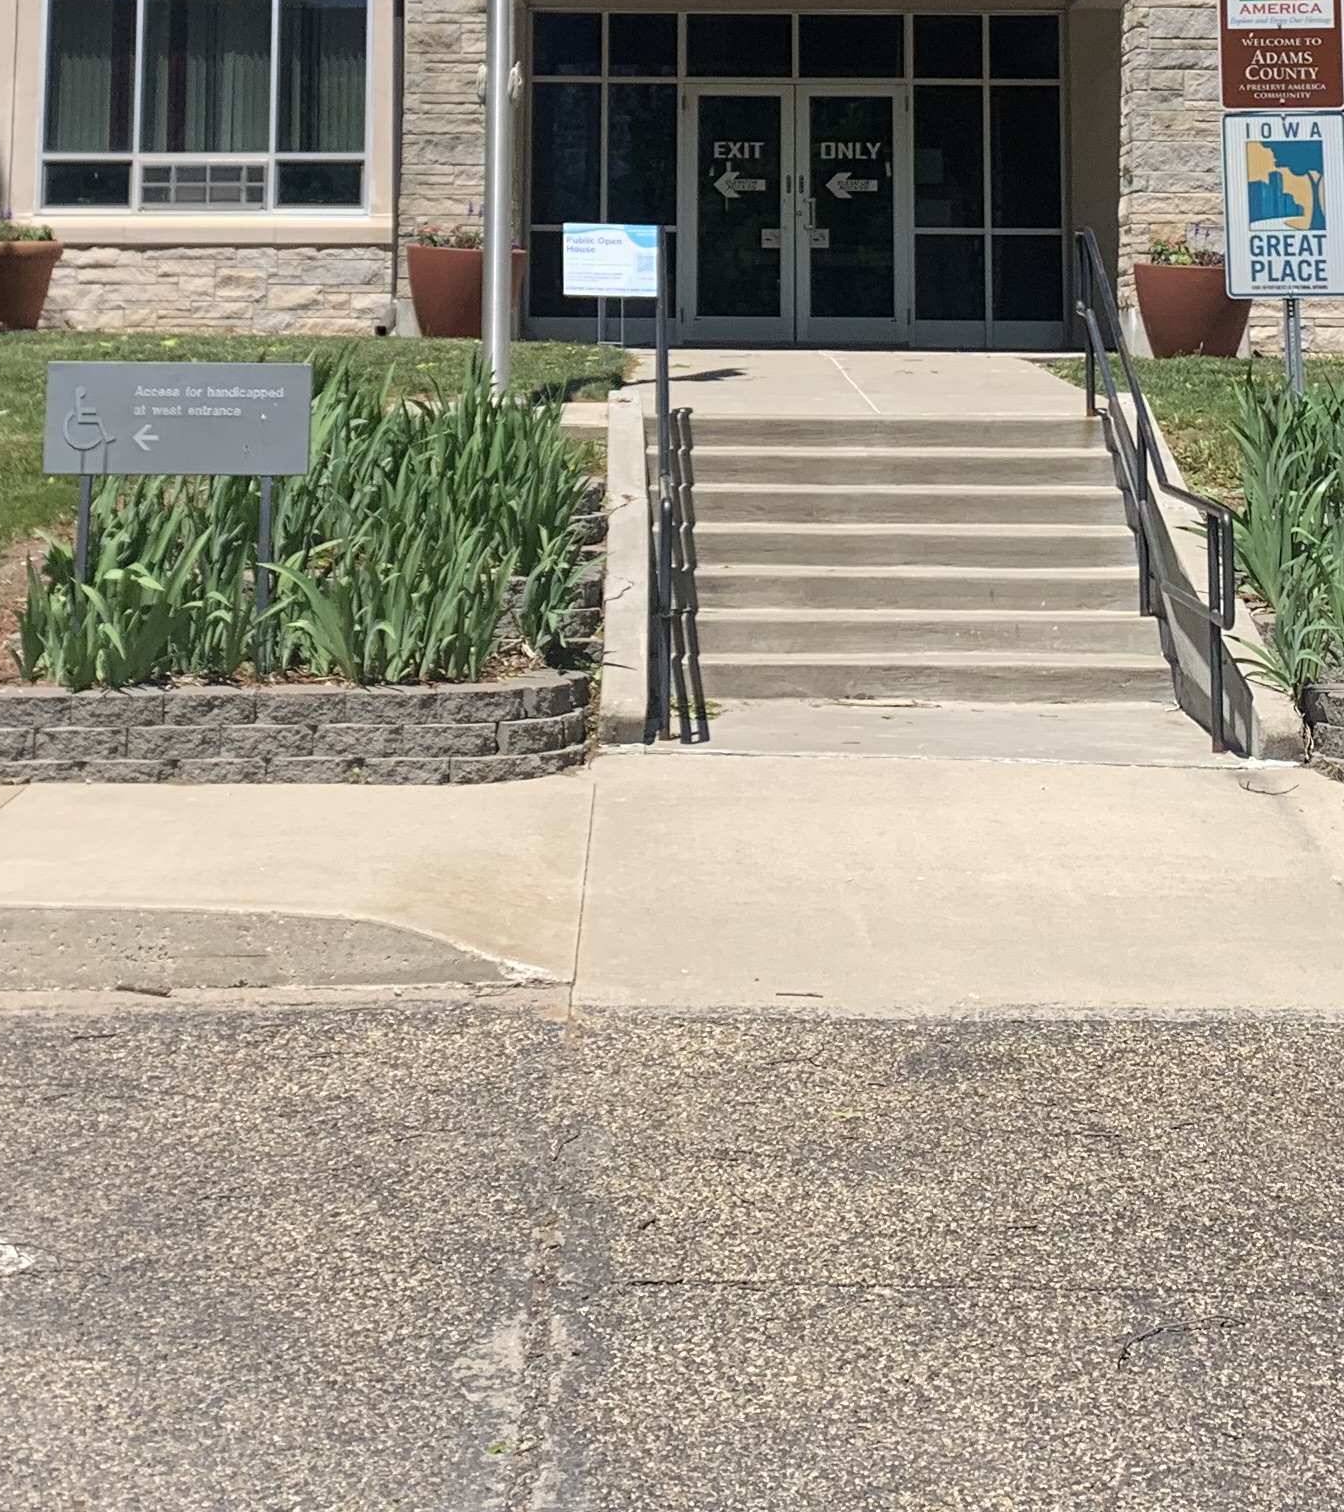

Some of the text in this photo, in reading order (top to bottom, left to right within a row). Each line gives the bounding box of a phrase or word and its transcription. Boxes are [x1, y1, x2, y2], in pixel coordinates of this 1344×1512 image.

[1239, 2, 1323, 15] AMERICA
[1241, 37, 1322, 47] WELCOME TO
[1251, 49, 1313, 65] ADAMS
[1245, 65, 1319, 81] COUNTY
[1253, 91, 1311, 99] COMMUNITY
[1245, 121, 1322, 139] IOWA
[713, 141, 765, 159] EXIT
[820, 141, 882, 160] ONLY
[566, 236, 623, 246] Public Open
[1249, 234, 1327, 257] GREAT
[566, 245, 596, 253] House
[1250, 259, 1328, 282] PLACE
[134, 385, 285, 400] Access for handicapped
[133, 404, 242, 417] at west entrance
